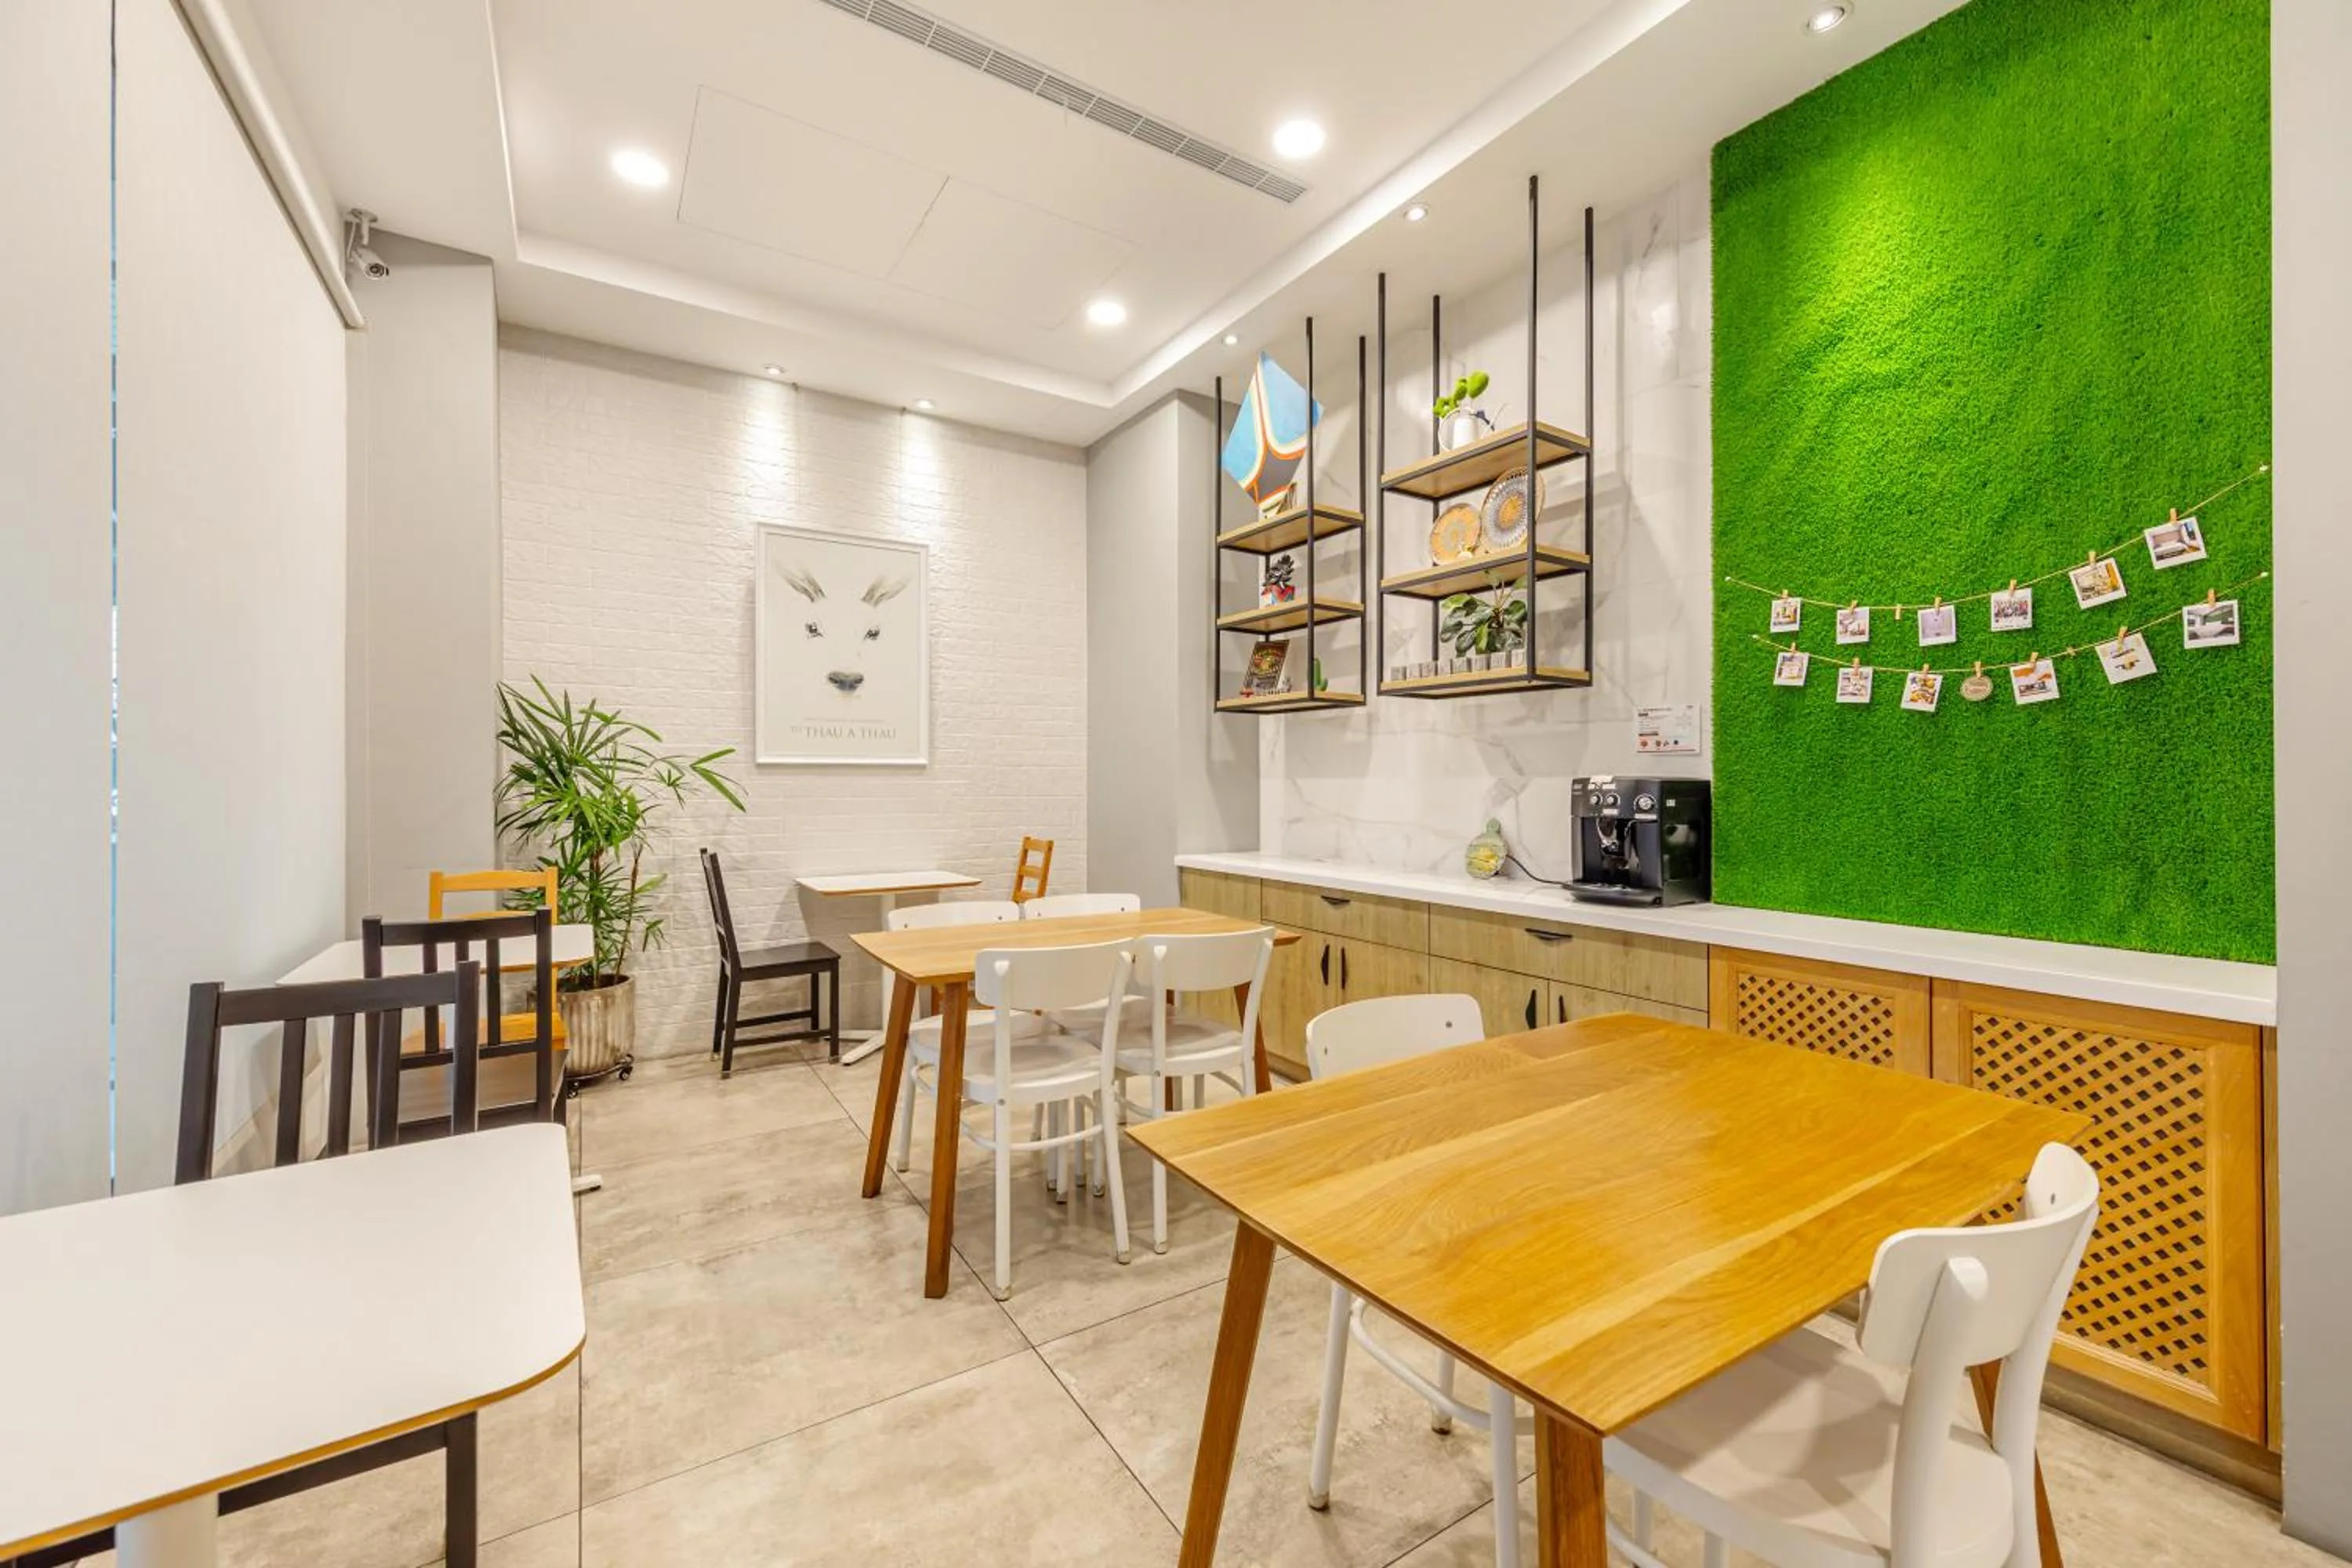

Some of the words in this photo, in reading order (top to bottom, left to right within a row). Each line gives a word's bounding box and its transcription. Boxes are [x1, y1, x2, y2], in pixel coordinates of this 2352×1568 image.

[804, 725, 843, 739] THAU
[847, 726, 855, 739] A
[860, 726, 896, 739] THAU
